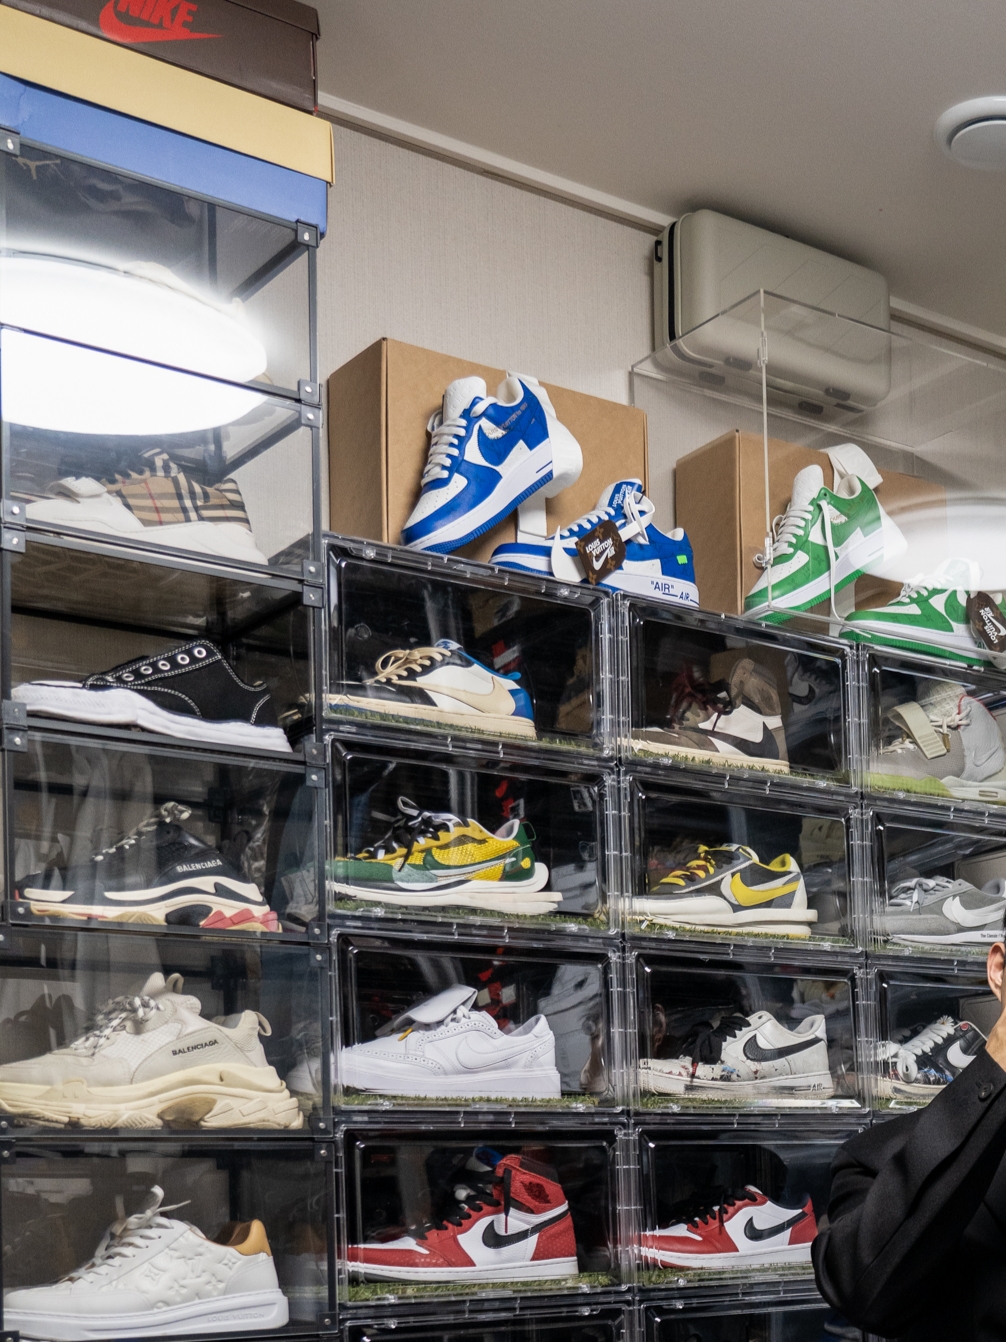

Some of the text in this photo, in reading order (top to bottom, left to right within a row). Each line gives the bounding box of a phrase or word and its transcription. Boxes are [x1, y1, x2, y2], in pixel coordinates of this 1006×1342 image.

[585, 538, 601, 553] LOUIS
[591, 537, 613, 557] VUITTON
[650, 580, 674, 593] "AIR"
[979, 609, 998, 635] VUITTON
[984, 625, 998, 644] LOUIS
[176, 858, 223, 873] BALENCIAGA
[171, 1039, 219, 1056] BALENCIAGA
